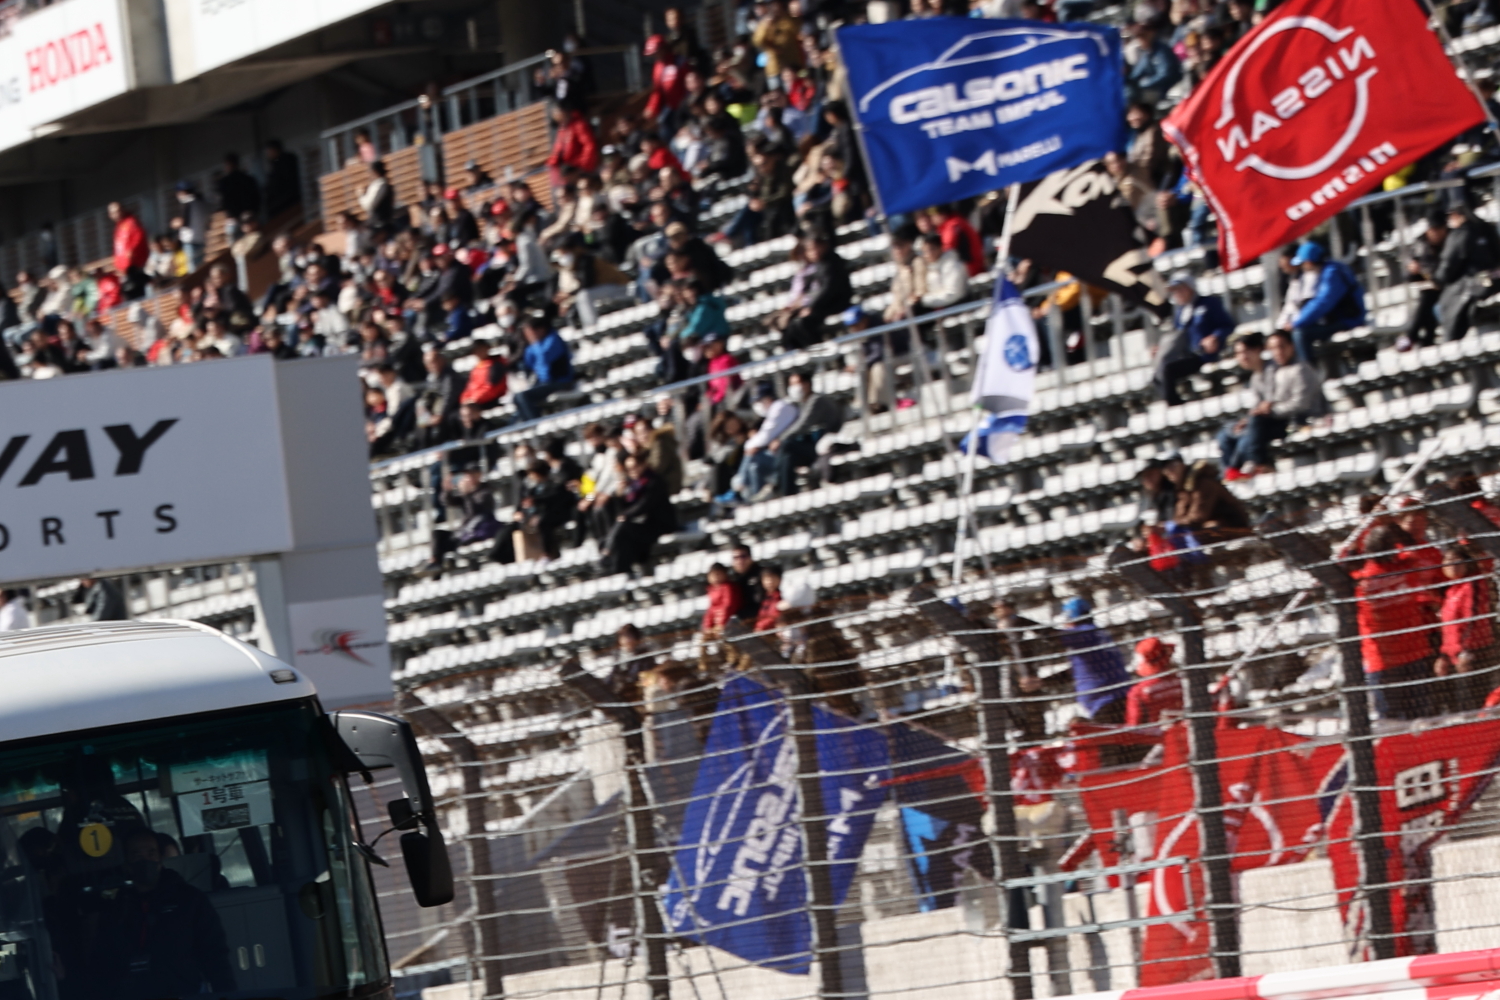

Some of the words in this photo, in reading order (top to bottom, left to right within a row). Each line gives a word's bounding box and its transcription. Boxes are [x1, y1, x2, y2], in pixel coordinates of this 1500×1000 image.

[25, 22, 112, 93] HONDA
[921, 111, 994, 139] TEAM
[89, 829, 101, 851] 1
